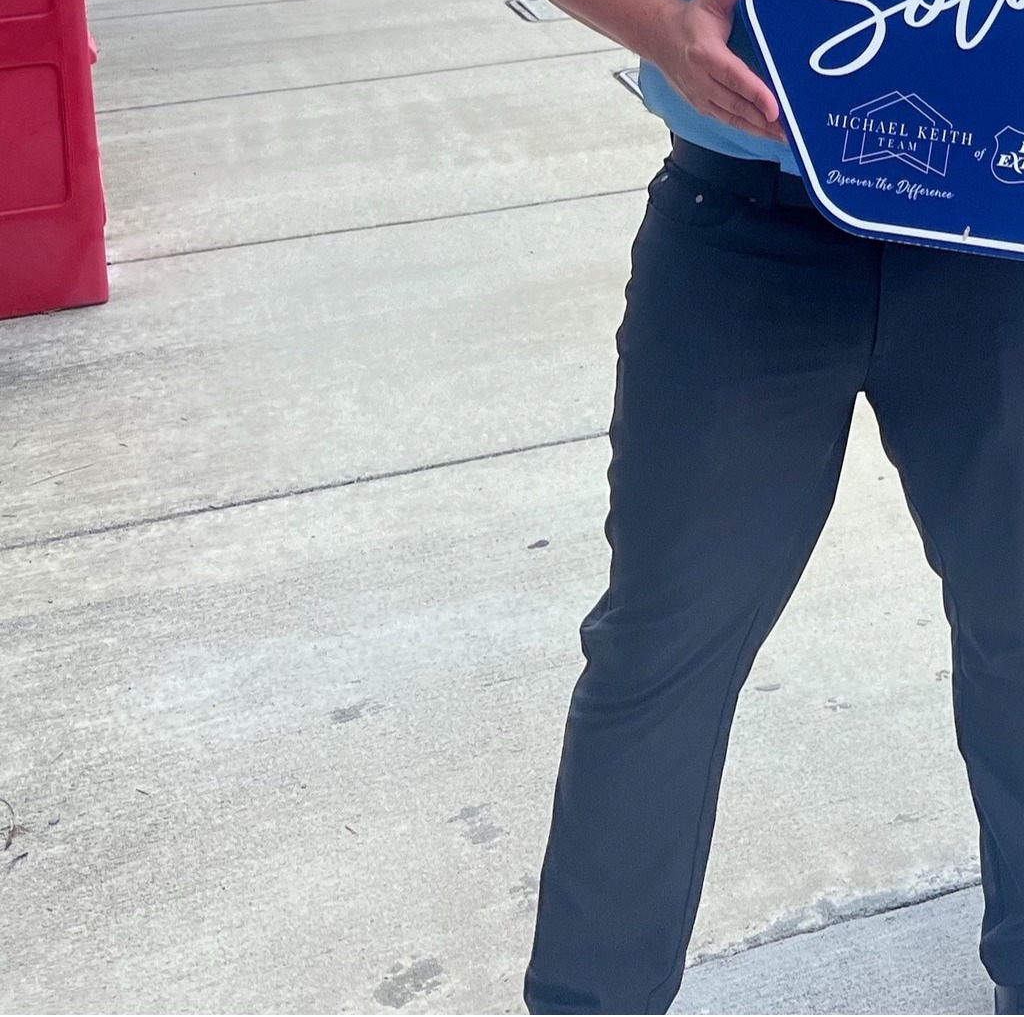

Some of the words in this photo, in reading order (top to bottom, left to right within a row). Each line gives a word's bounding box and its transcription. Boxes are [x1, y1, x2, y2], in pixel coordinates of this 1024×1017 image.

[827, 113, 908, 136] MICHAEL
[917, 125, 973, 146] KEITH
[878, 137, 917, 152] TEAM
[974, 147, 986, 161] of
[827, 169, 874, 189] Discover
[873, 176, 894, 191] the
[896, 179, 954, 200] Difference
